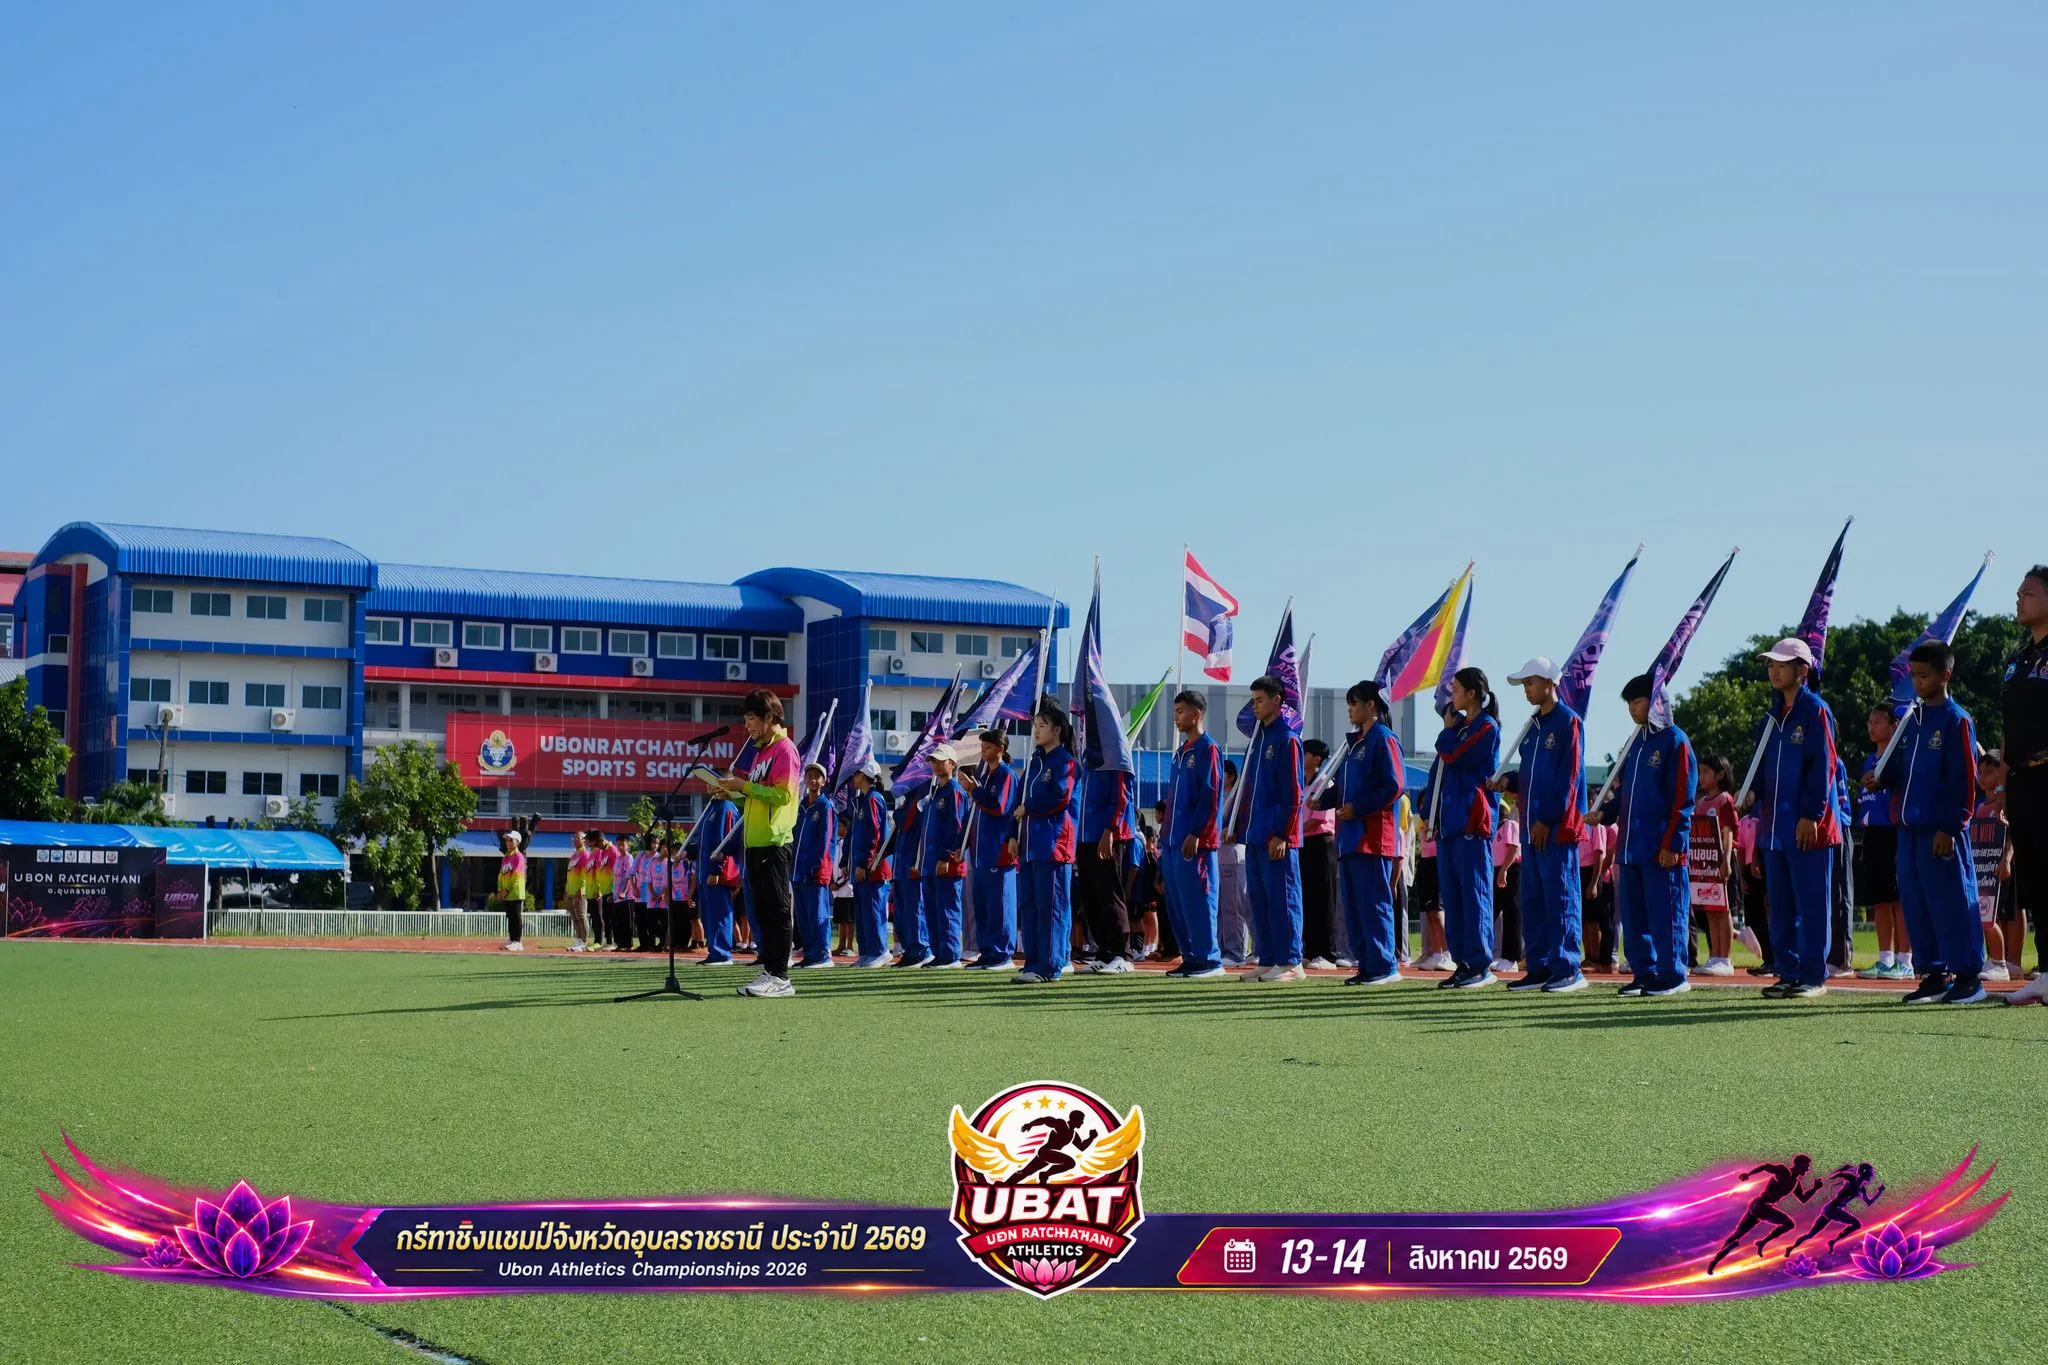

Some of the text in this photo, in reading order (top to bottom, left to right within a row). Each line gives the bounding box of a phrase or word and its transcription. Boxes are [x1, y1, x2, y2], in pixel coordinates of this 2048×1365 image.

[540, 735, 734, 758] UBONRATCHATHANI
[562, 758, 714, 779] SPORTS SCHO
[14, 872, 141, 885] UBON RATCHATHANI
[163, 892, 199, 902] UBON
